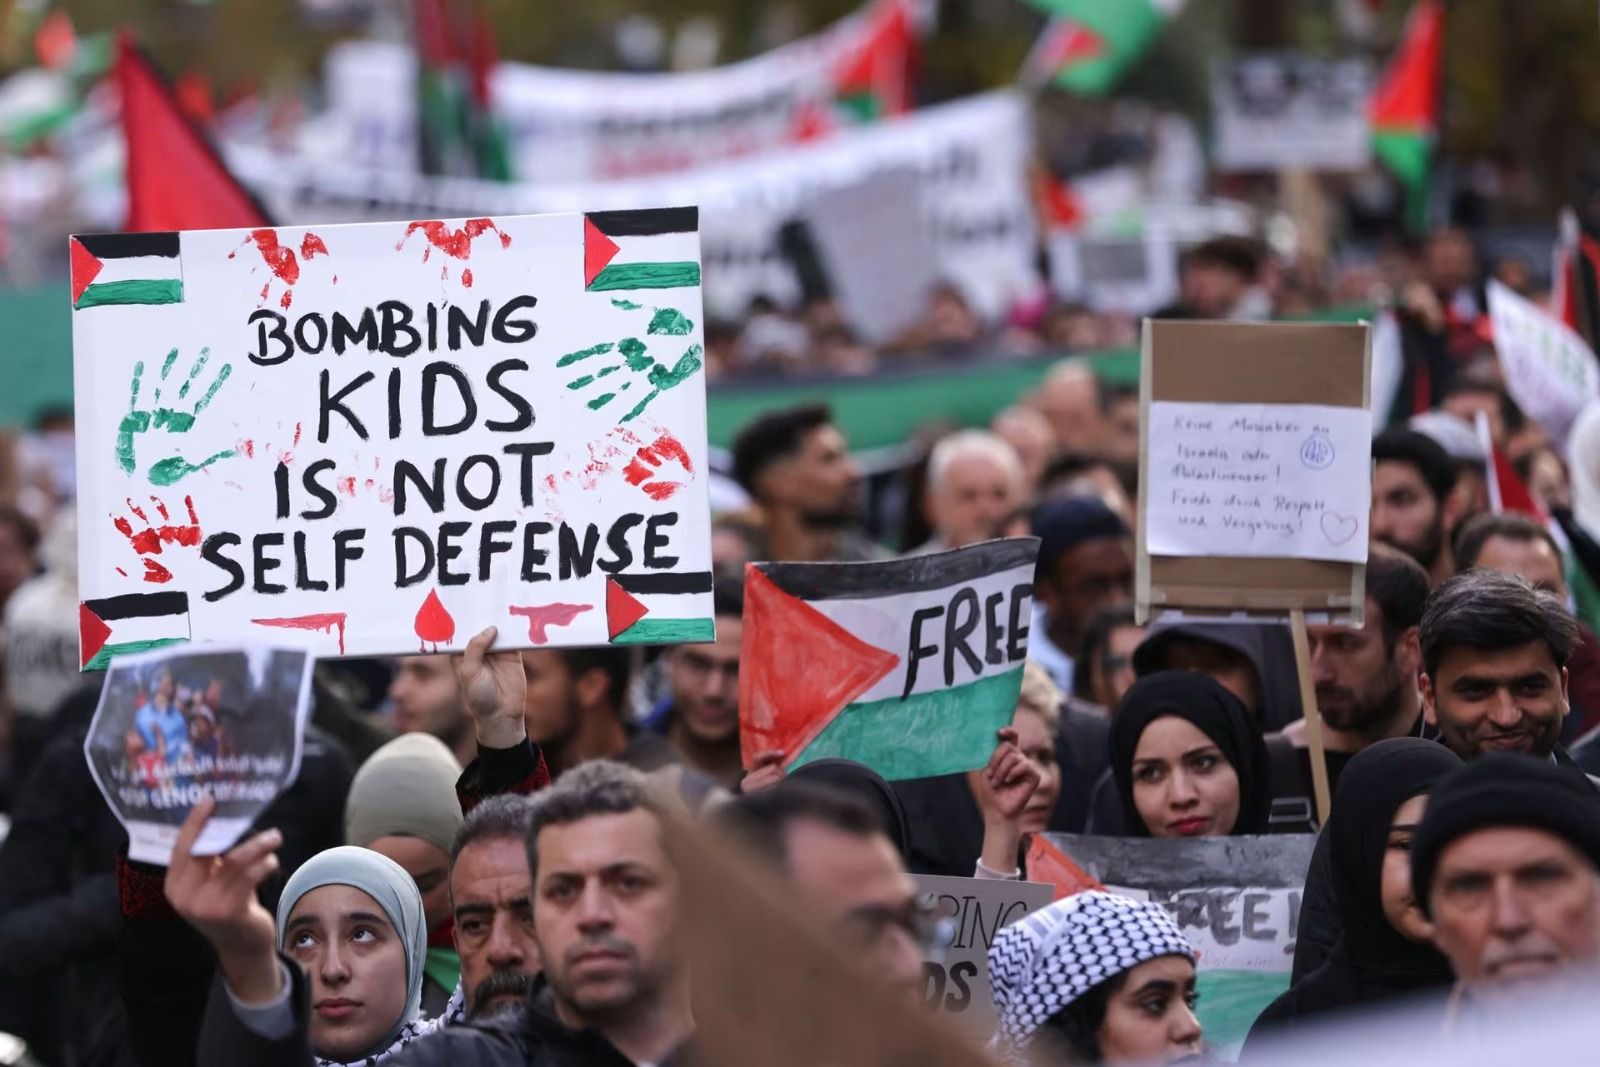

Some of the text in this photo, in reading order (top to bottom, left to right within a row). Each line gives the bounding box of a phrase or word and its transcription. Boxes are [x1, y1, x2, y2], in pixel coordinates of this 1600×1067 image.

[248, 295, 538, 366] BOMBING
[318, 359, 536, 443] KIDS
[274, 441, 555, 520] IS NOT
[201, 511, 679, 602] SELF DEFENSE
[900, 583, 1034, 702] FREE
